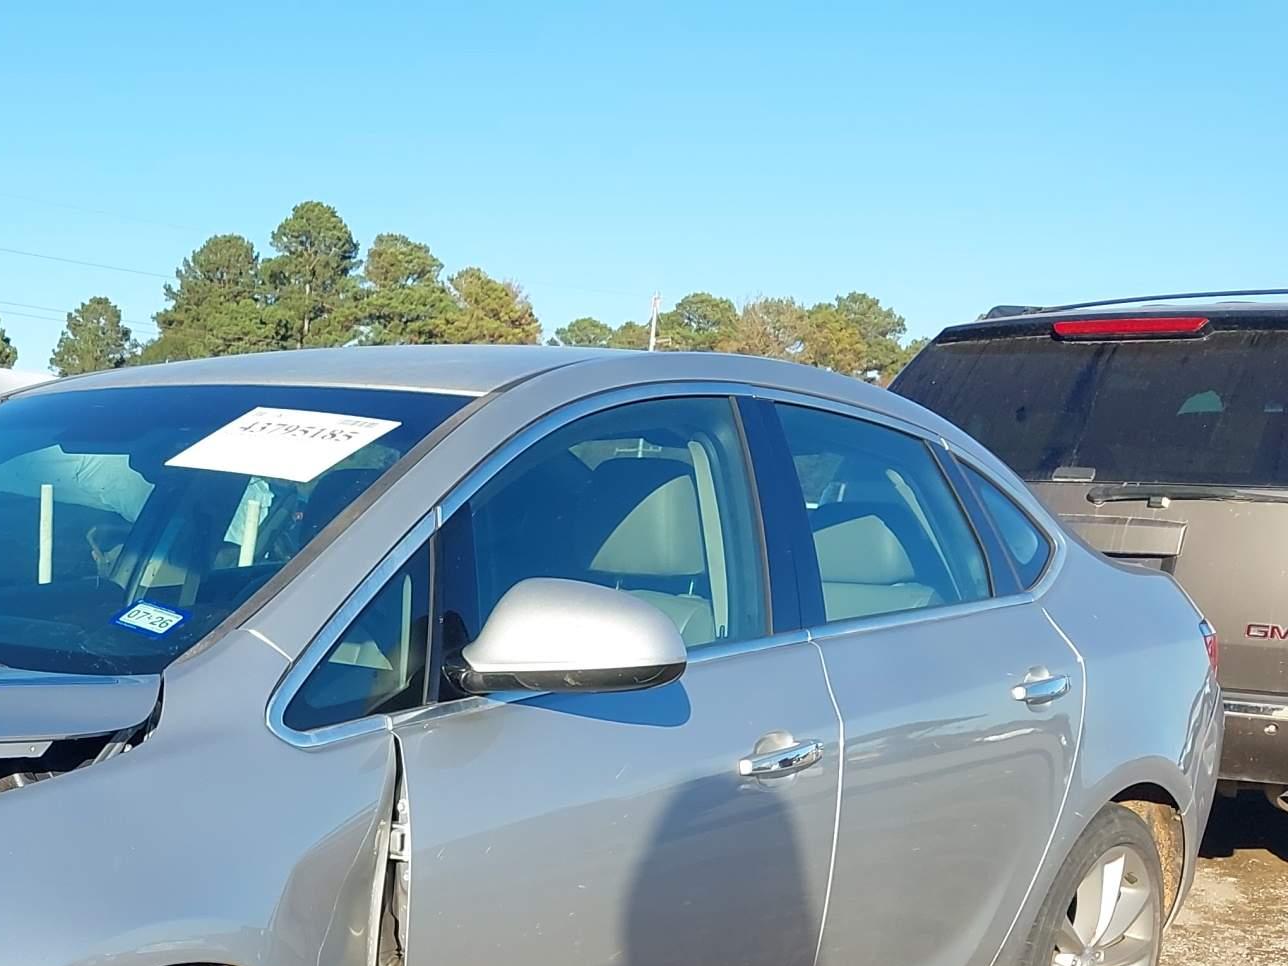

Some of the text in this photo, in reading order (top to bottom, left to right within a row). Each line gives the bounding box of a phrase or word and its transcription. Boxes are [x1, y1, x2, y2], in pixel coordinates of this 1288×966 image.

[239, 420, 360, 442] 43795185
[127, 609, 150, 621] 07
[149, 616, 173, 629] 26
